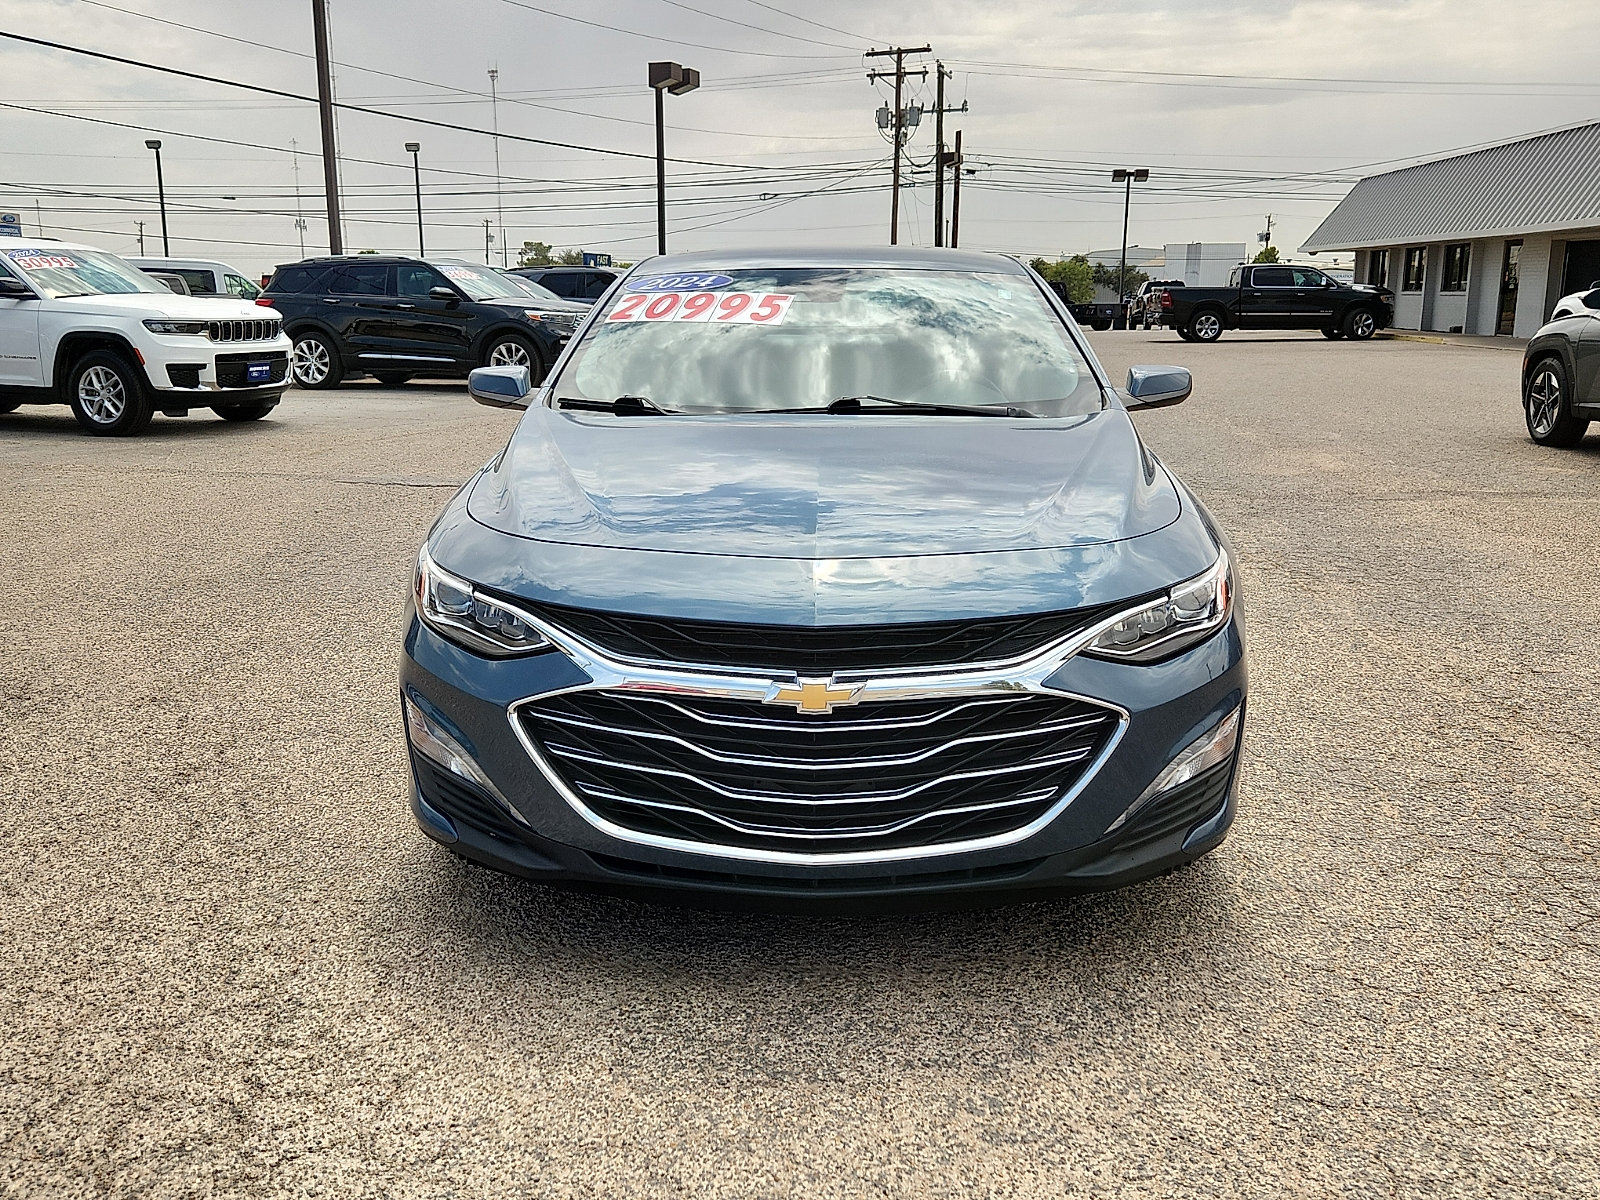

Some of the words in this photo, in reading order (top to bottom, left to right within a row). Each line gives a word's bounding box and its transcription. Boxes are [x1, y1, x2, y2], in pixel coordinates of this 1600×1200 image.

[13, 249, 36, 258] 2024
[597, 255, 609, 264] FAST
[17, 256, 75, 269] 30995
[639, 275, 714, 290] 2024
[609, 293, 791, 321] 20995
